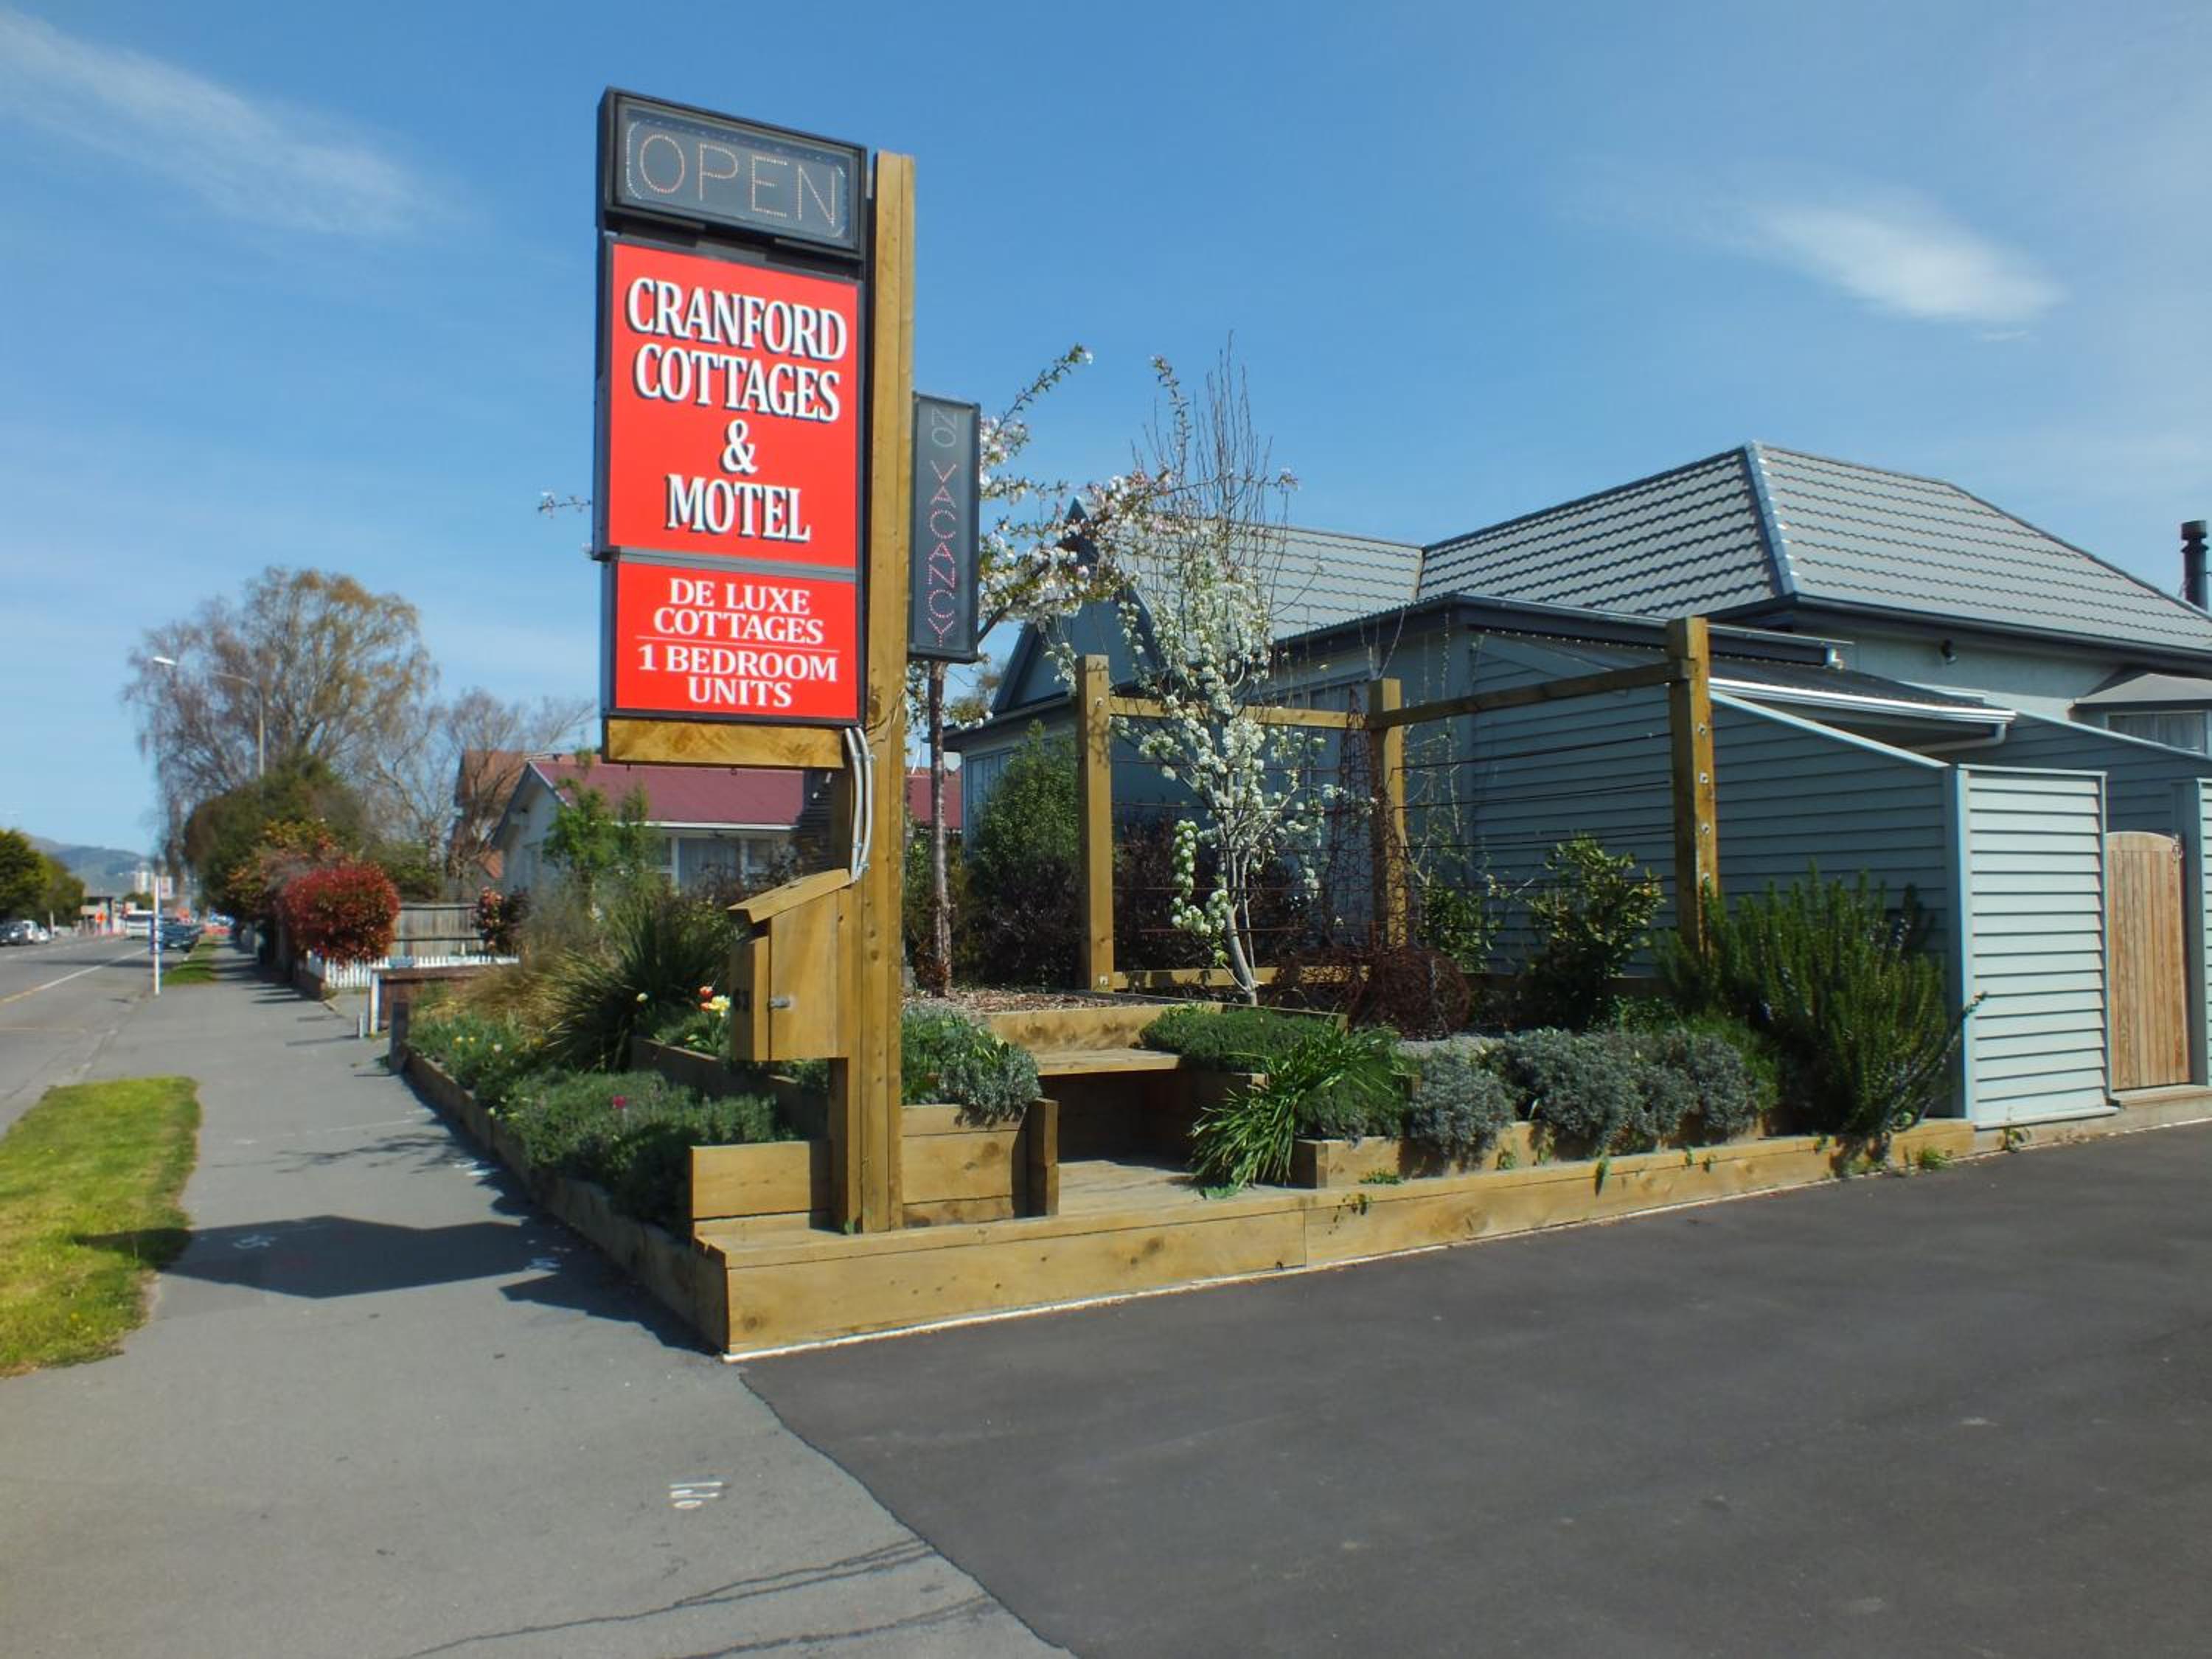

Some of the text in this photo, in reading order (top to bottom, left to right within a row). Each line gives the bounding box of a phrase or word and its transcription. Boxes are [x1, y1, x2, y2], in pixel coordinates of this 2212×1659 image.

[639, 133, 836, 226] OPEN
[628, 276, 847, 362] CRANFORD
[634, 343, 841, 422] COTTAGES
[720, 419, 758, 473] &
[931, 408, 957, 448] NO
[665, 473, 811, 543] MOTEL
[928, 459, 956, 647] VACANCY
[669, 577, 810, 616] DE LUXE
[653, 607, 824, 646] COTTAGES
[637, 644, 838, 682] 1 BEDROOM
[687, 676, 793, 708] UNITS
